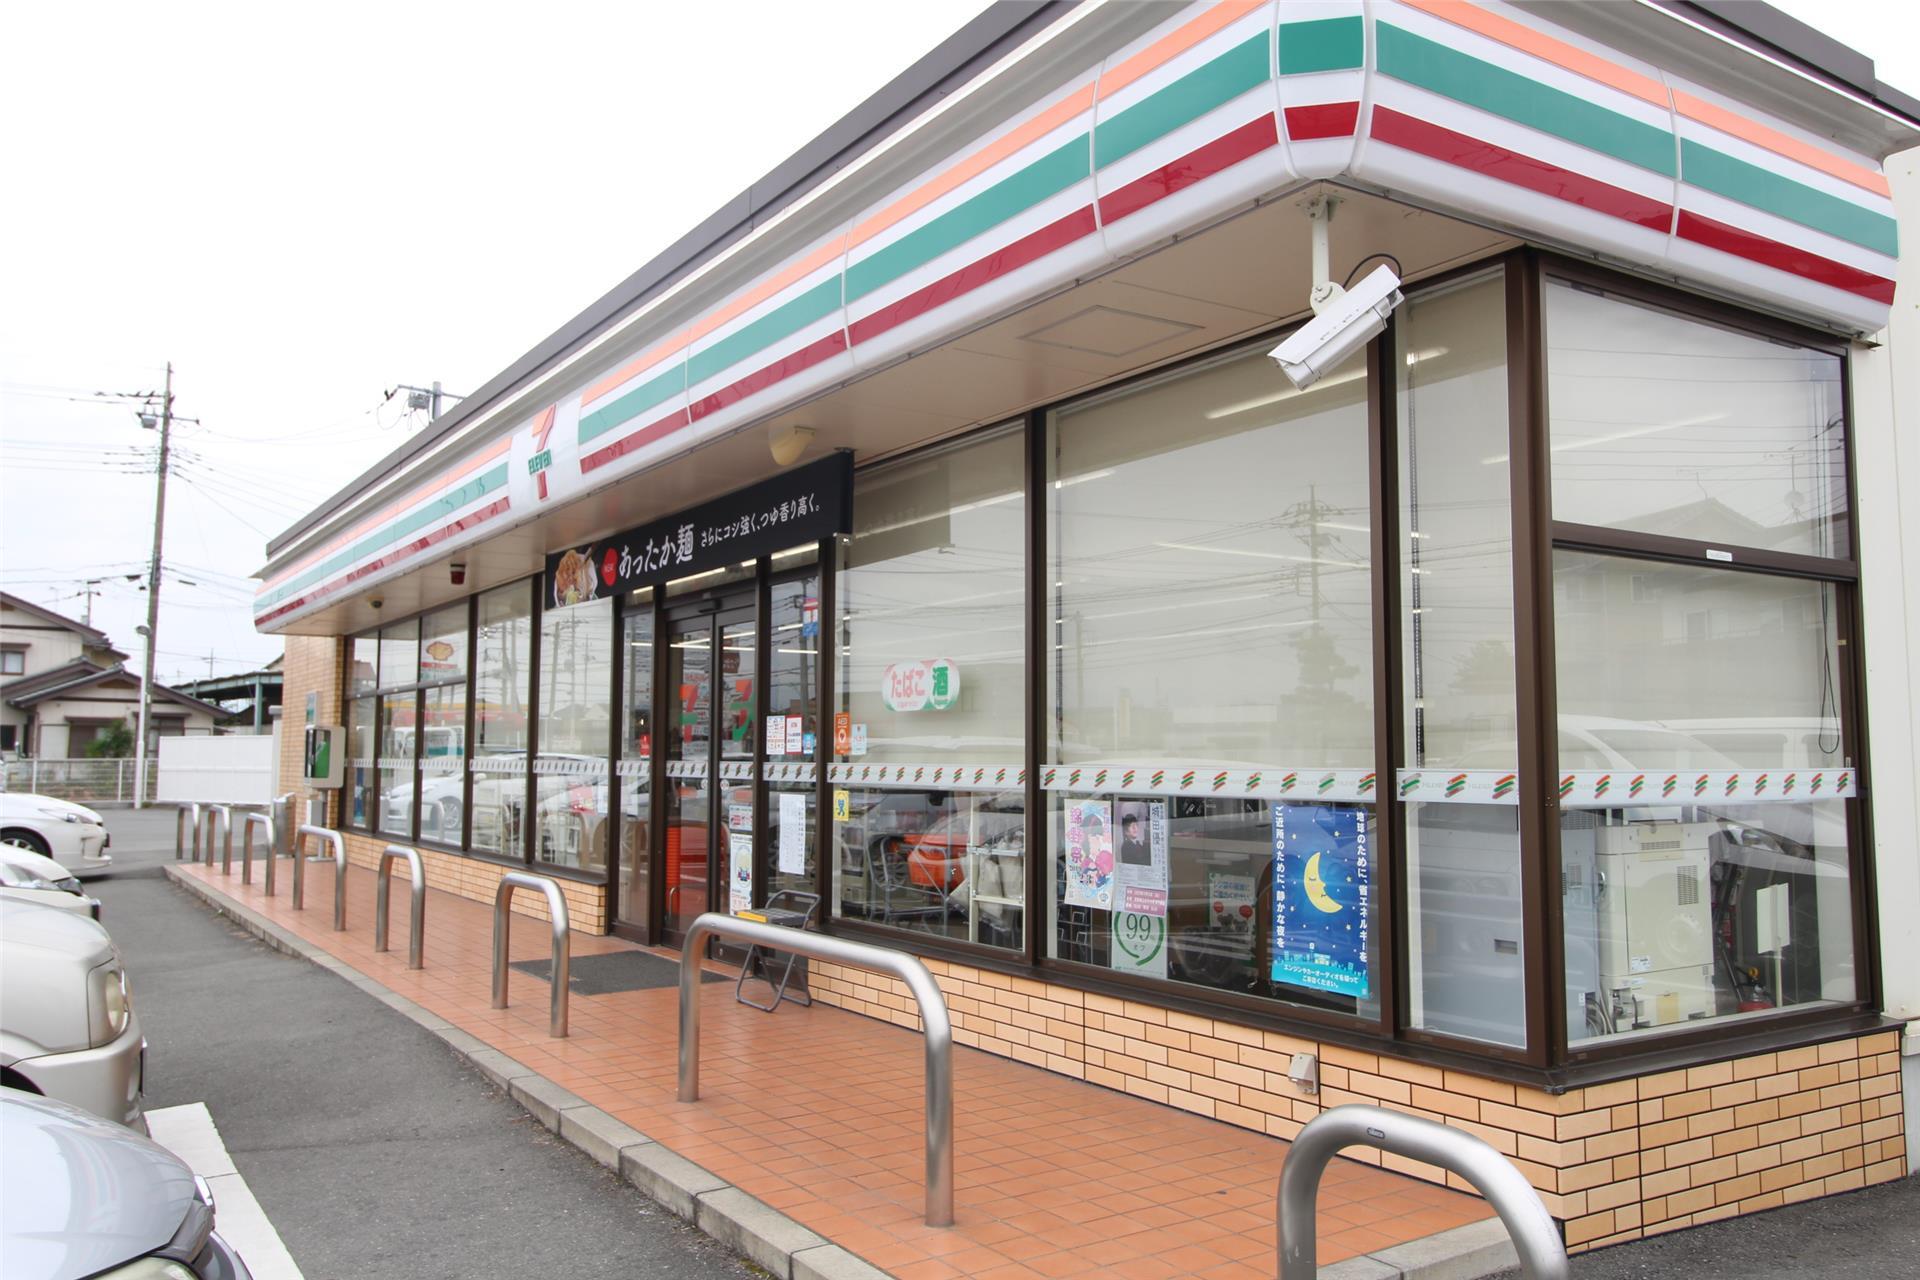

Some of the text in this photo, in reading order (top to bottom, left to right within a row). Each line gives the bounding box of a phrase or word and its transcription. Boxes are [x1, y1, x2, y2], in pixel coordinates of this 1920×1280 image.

[618, 493, 820, 580] あったか麺 さらにコシ強く、つゆ香り高く。
[891, 668, 925, 698] たばこ
[1275, 806, 1286, 949] ご近所のために、静かな夜を
[1356, 811, 1368, 963] 地球のために、省エネルギーを
